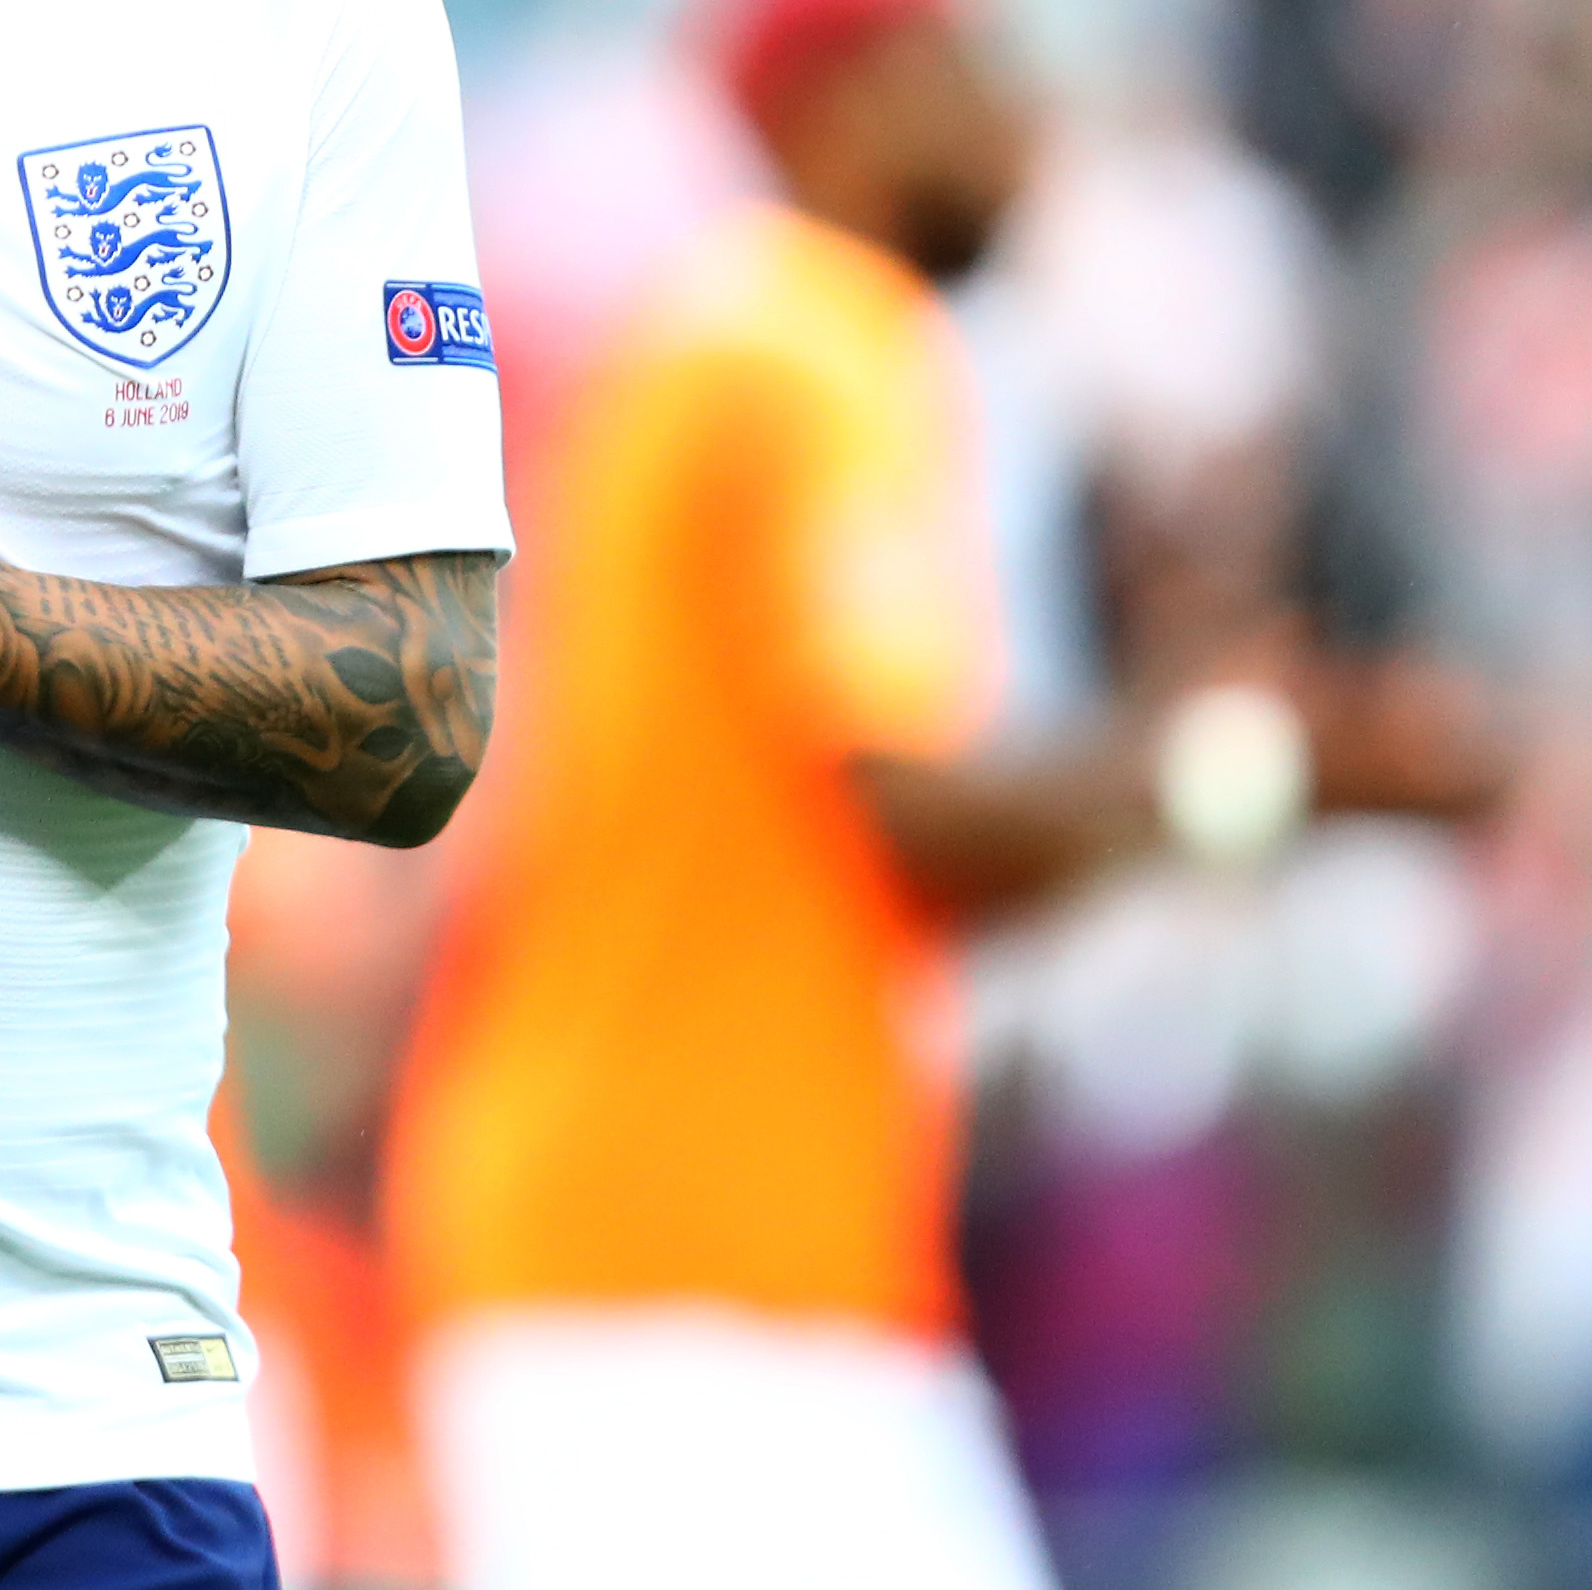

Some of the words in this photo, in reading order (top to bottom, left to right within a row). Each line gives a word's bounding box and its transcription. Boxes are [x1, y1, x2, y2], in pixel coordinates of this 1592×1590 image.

[115, 378, 182, 401] HOLLAND
[121, 407, 156, 427] JUNE
[159, 401, 189, 425] 2019
